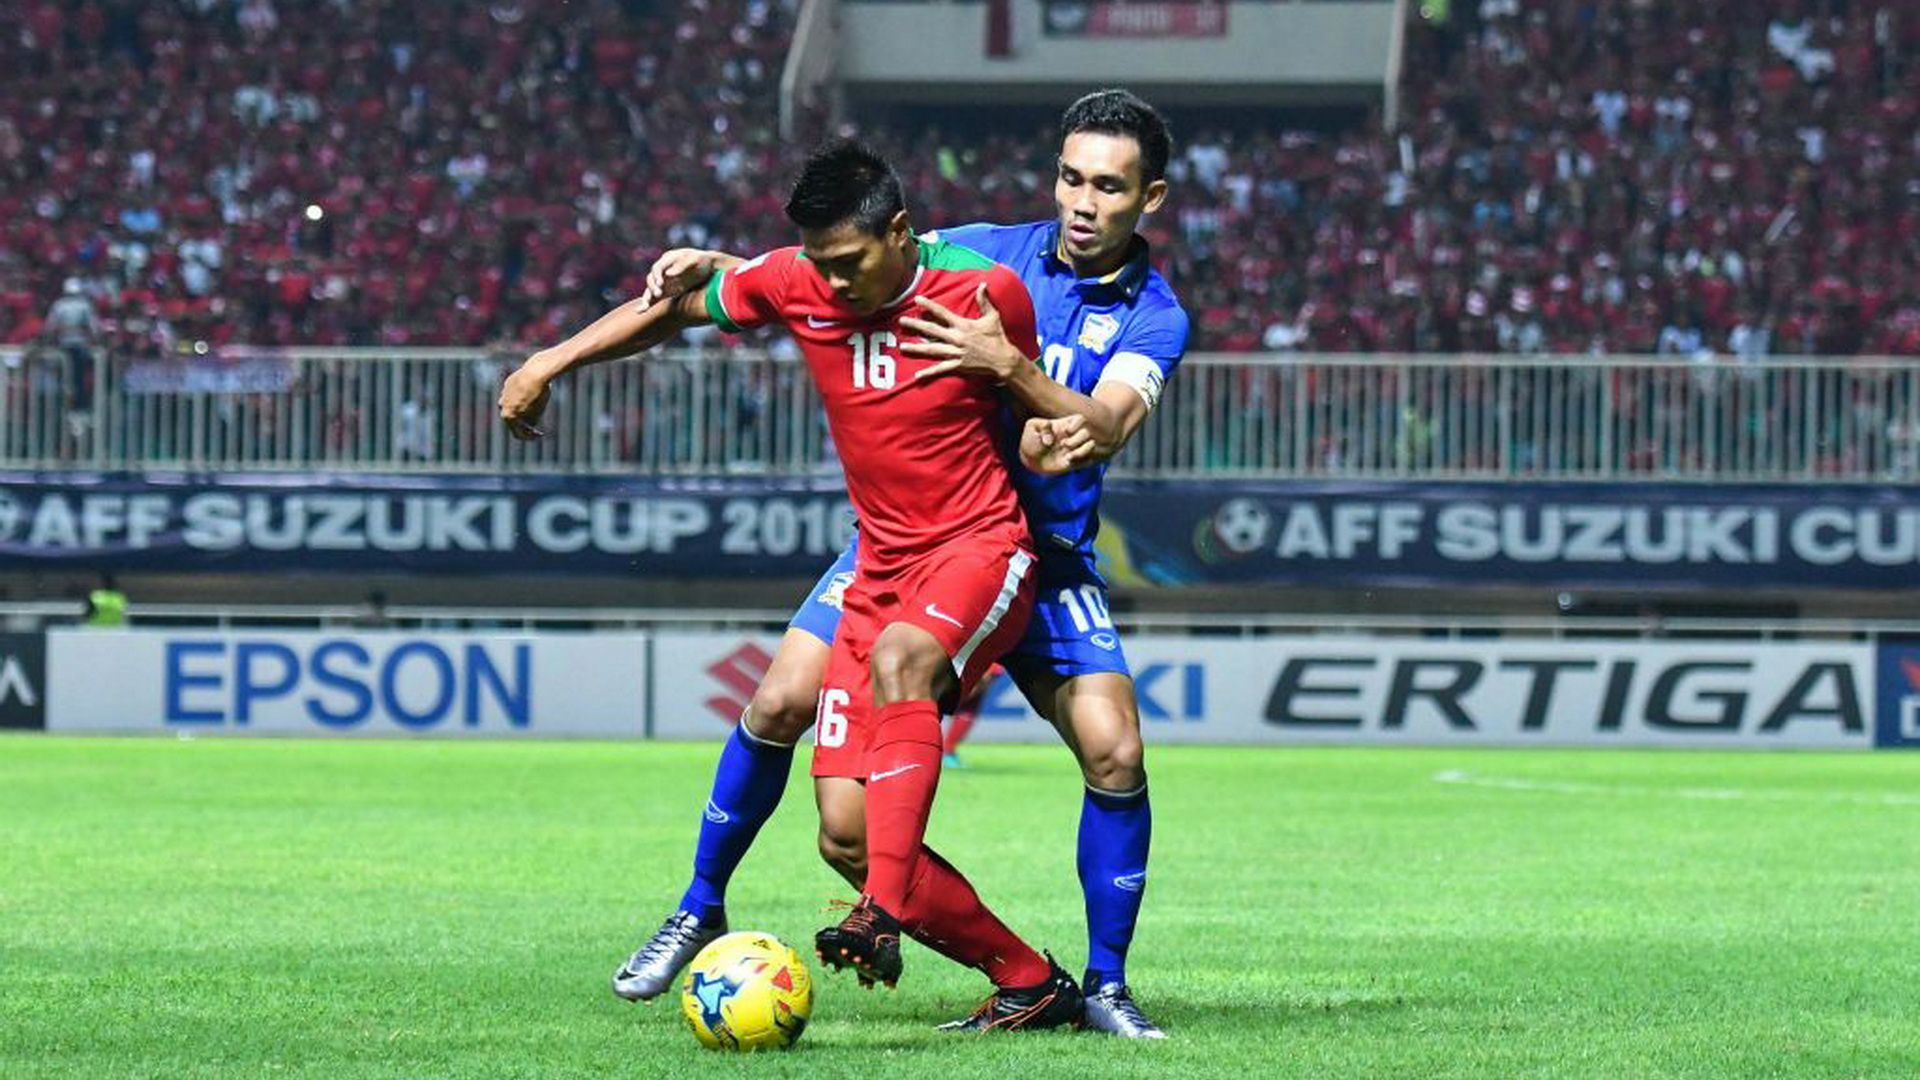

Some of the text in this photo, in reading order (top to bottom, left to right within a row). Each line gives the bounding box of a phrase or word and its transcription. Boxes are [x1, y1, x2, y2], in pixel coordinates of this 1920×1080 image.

[848, 331, 897, 391] 16
[27, 495, 171, 550] AFF
[181, 493, 516, 551] SUZUKI
[527, 496, 711, 553] CUP
[1277, 501, 1920, 564] AFF SUZUKI CU
[1058, 582, 1114, 635] 10
[163, 640, 533, 731] EPSON
[1261, 656, 1866, 734] ERTIGA
